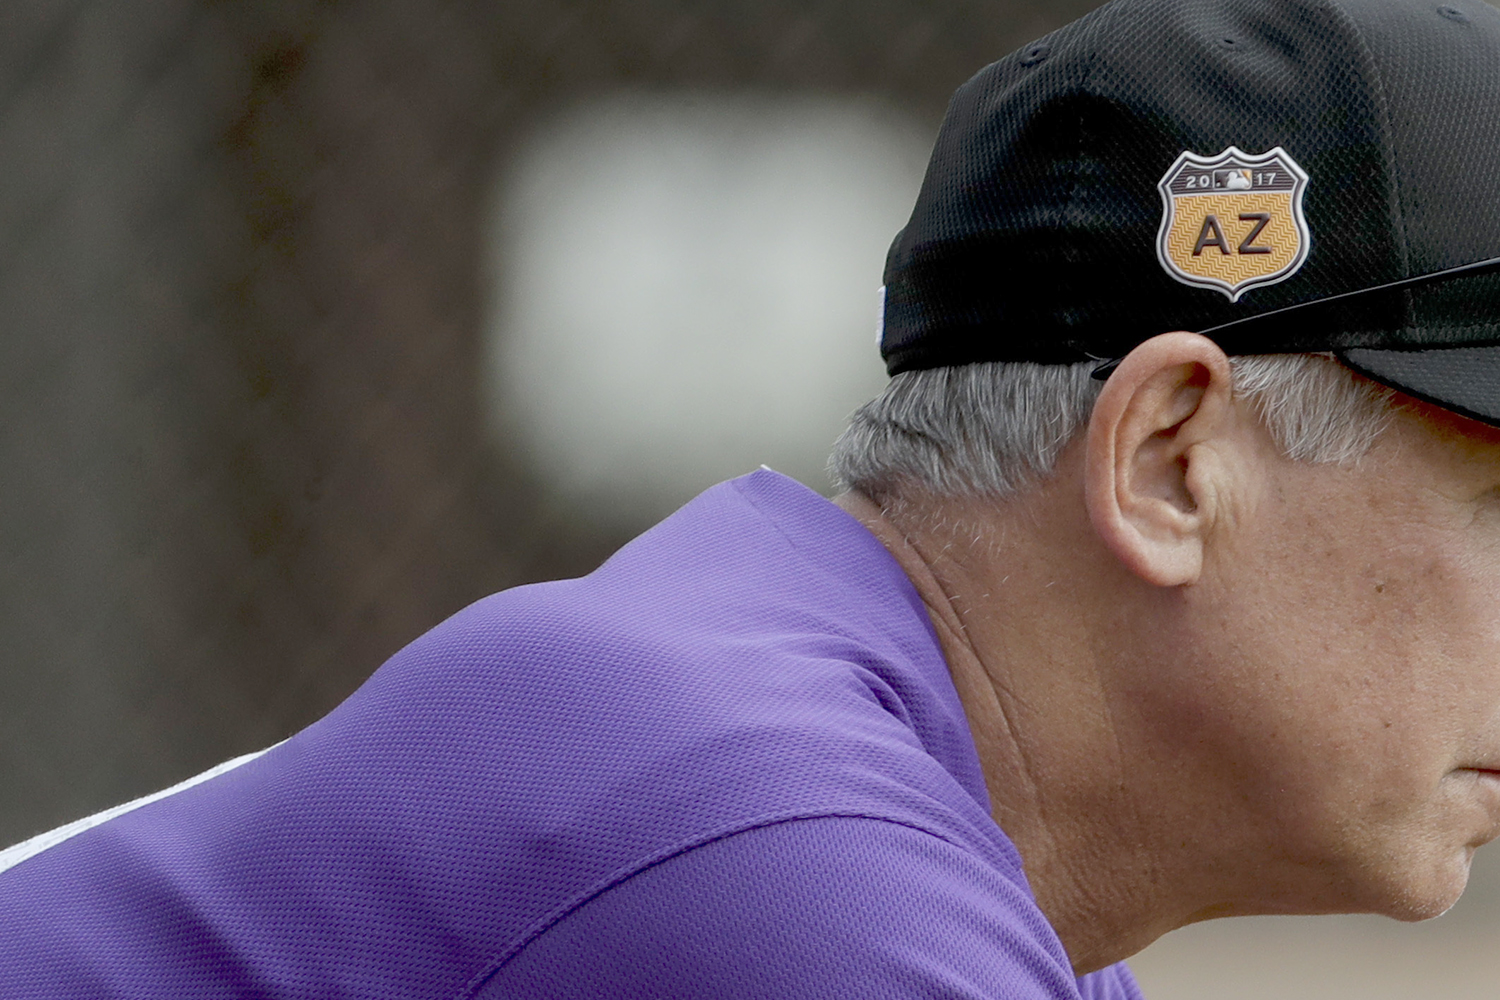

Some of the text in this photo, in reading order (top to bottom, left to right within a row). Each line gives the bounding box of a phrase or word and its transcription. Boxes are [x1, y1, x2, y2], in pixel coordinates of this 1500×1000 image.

[1185, 172, 1277, 189] 20 17
[1192, 212, 1273, 257] AZ
